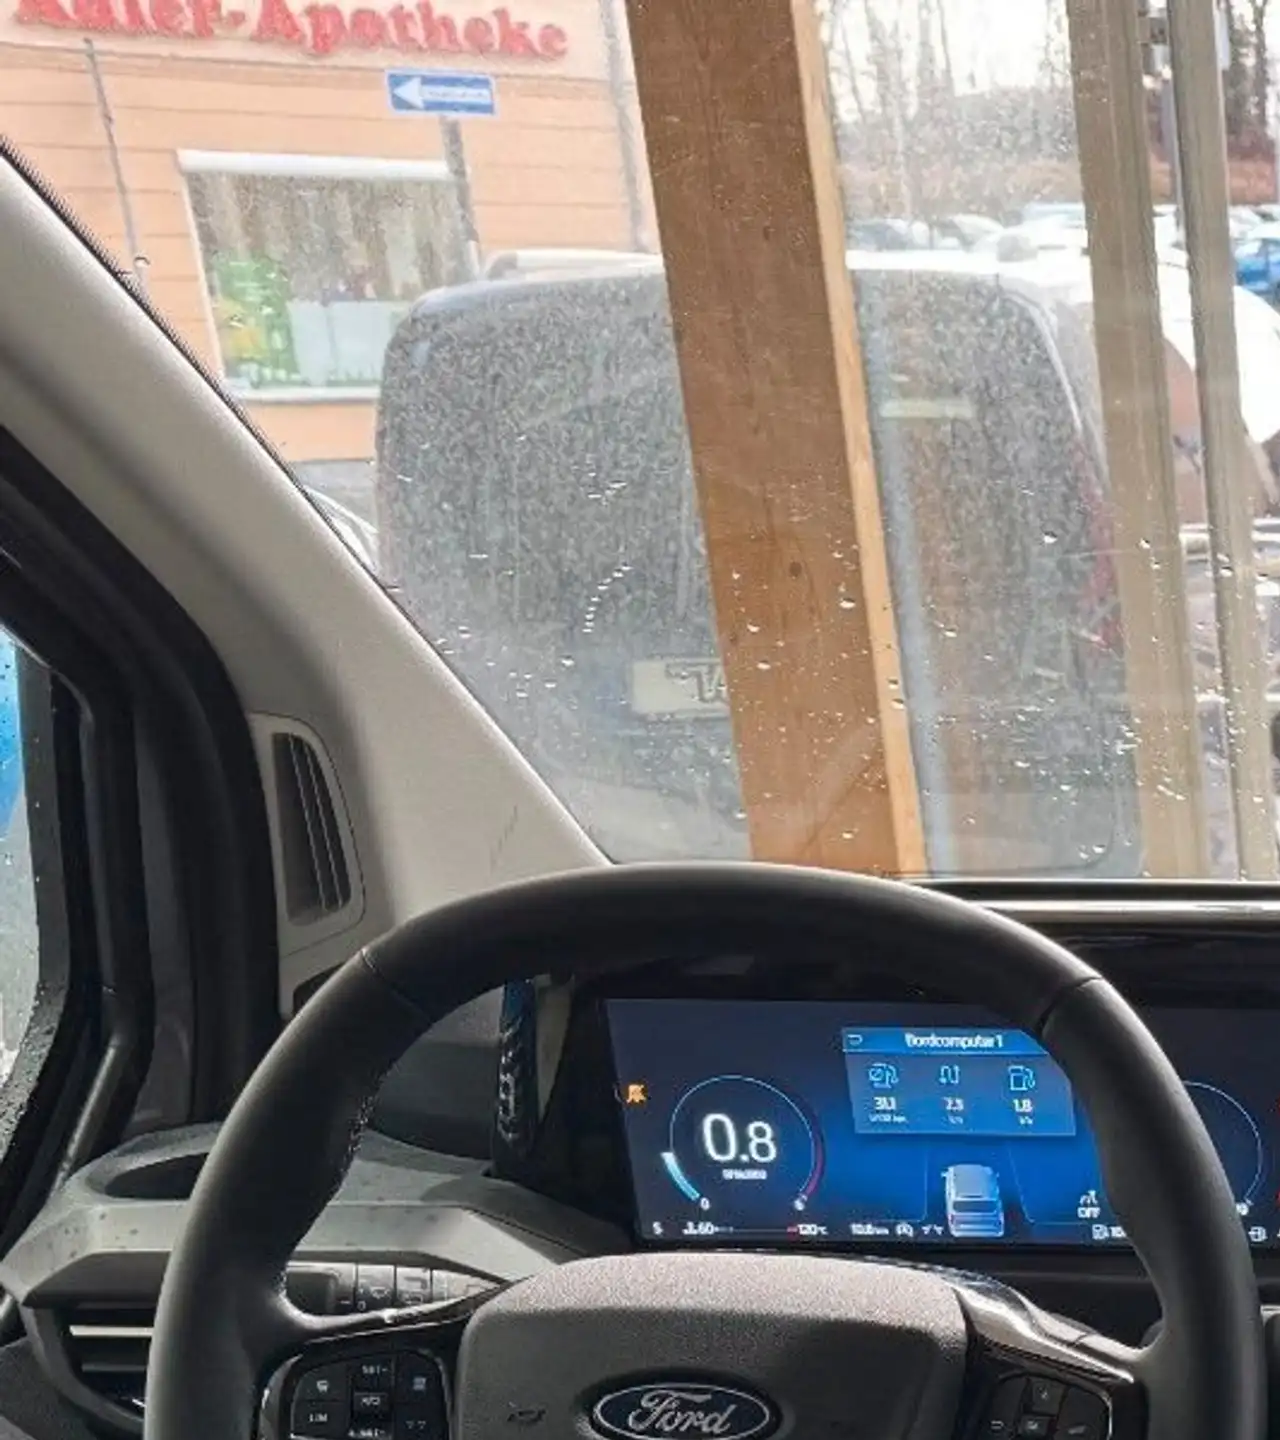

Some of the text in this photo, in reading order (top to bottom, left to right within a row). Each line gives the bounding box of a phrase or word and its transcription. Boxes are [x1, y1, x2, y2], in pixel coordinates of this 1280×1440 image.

[904, 1032, 994, 1050] Bordcomputer
[703, 1113, 777, 1163] 0.8
[628, 1386, 738, 1436] Ford
